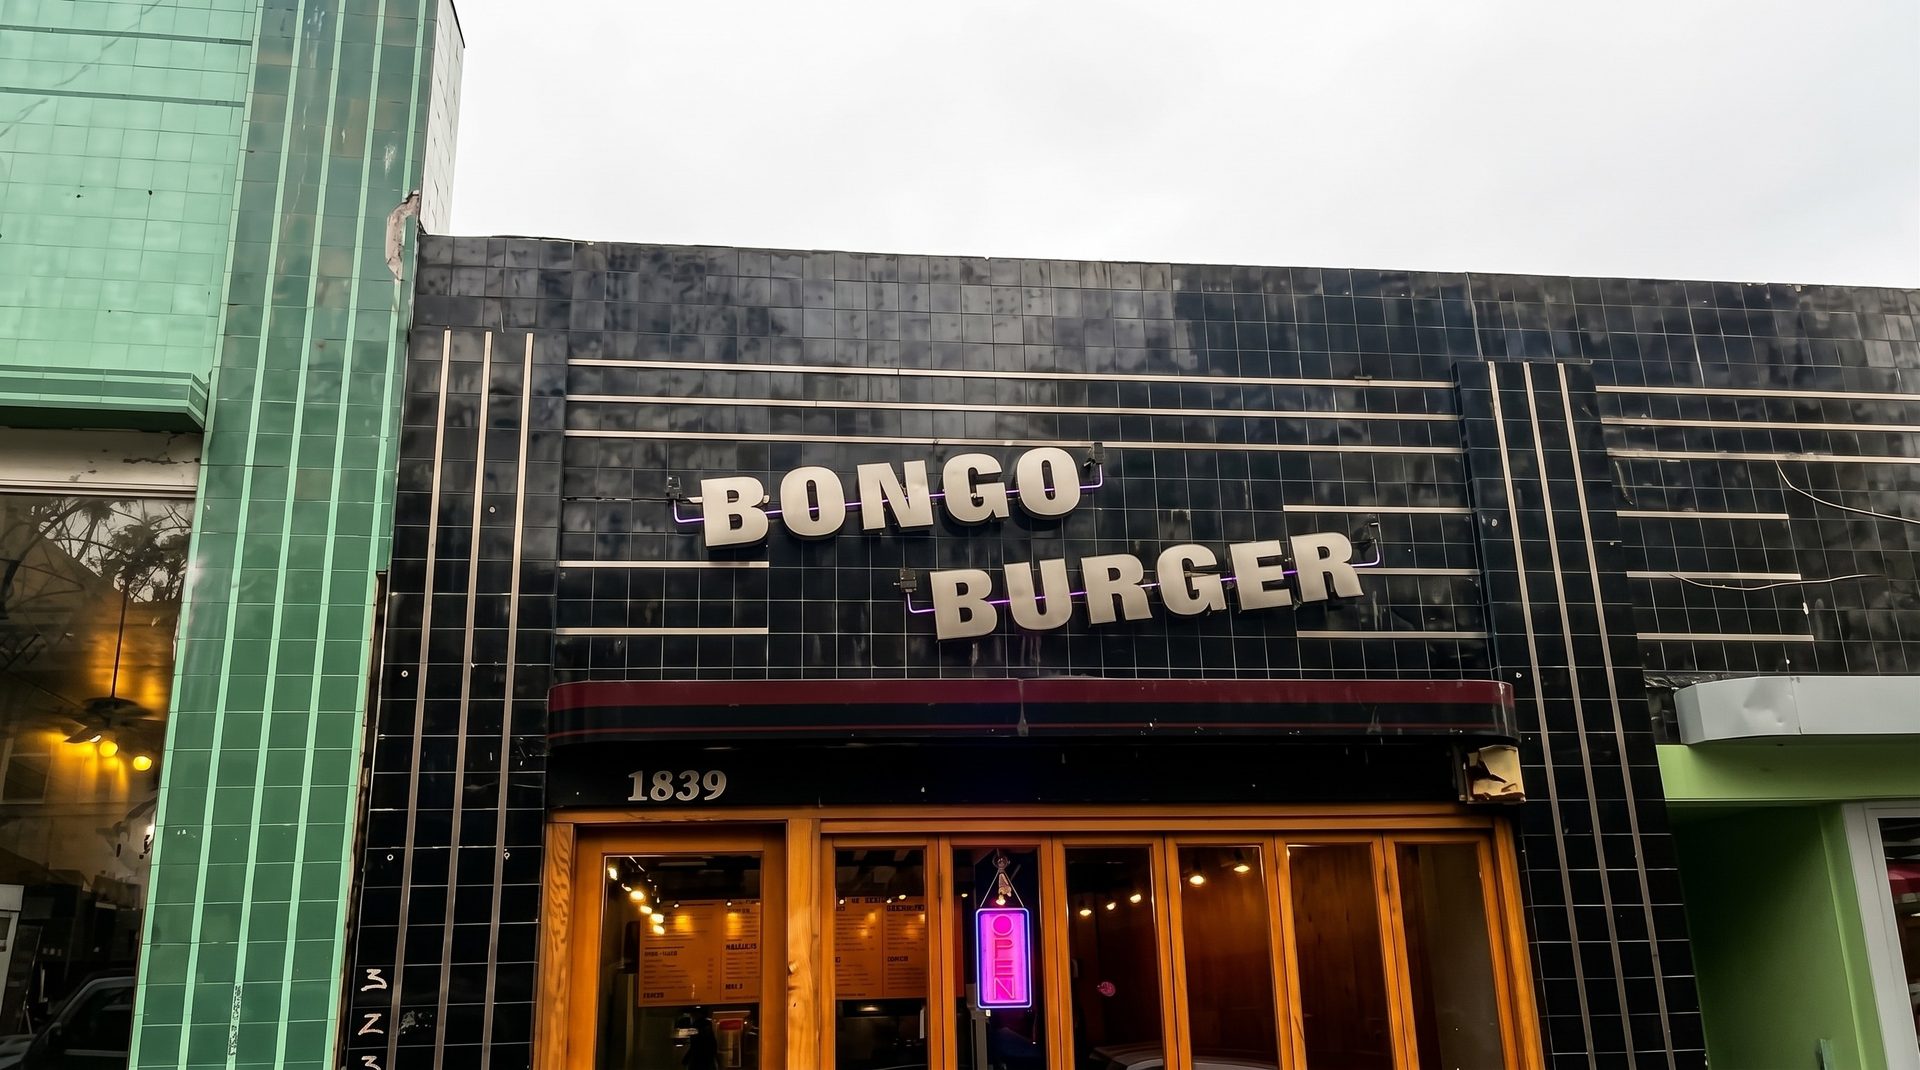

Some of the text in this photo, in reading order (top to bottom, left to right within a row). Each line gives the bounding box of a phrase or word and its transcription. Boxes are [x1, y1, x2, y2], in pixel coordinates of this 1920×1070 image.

[701, 446, 1081, 550] BONGO
[929, 531, 1364, 641] BURGER
[627, 769, 727, 802] 1839
[992, 913, 1016, 1000] OPEN
